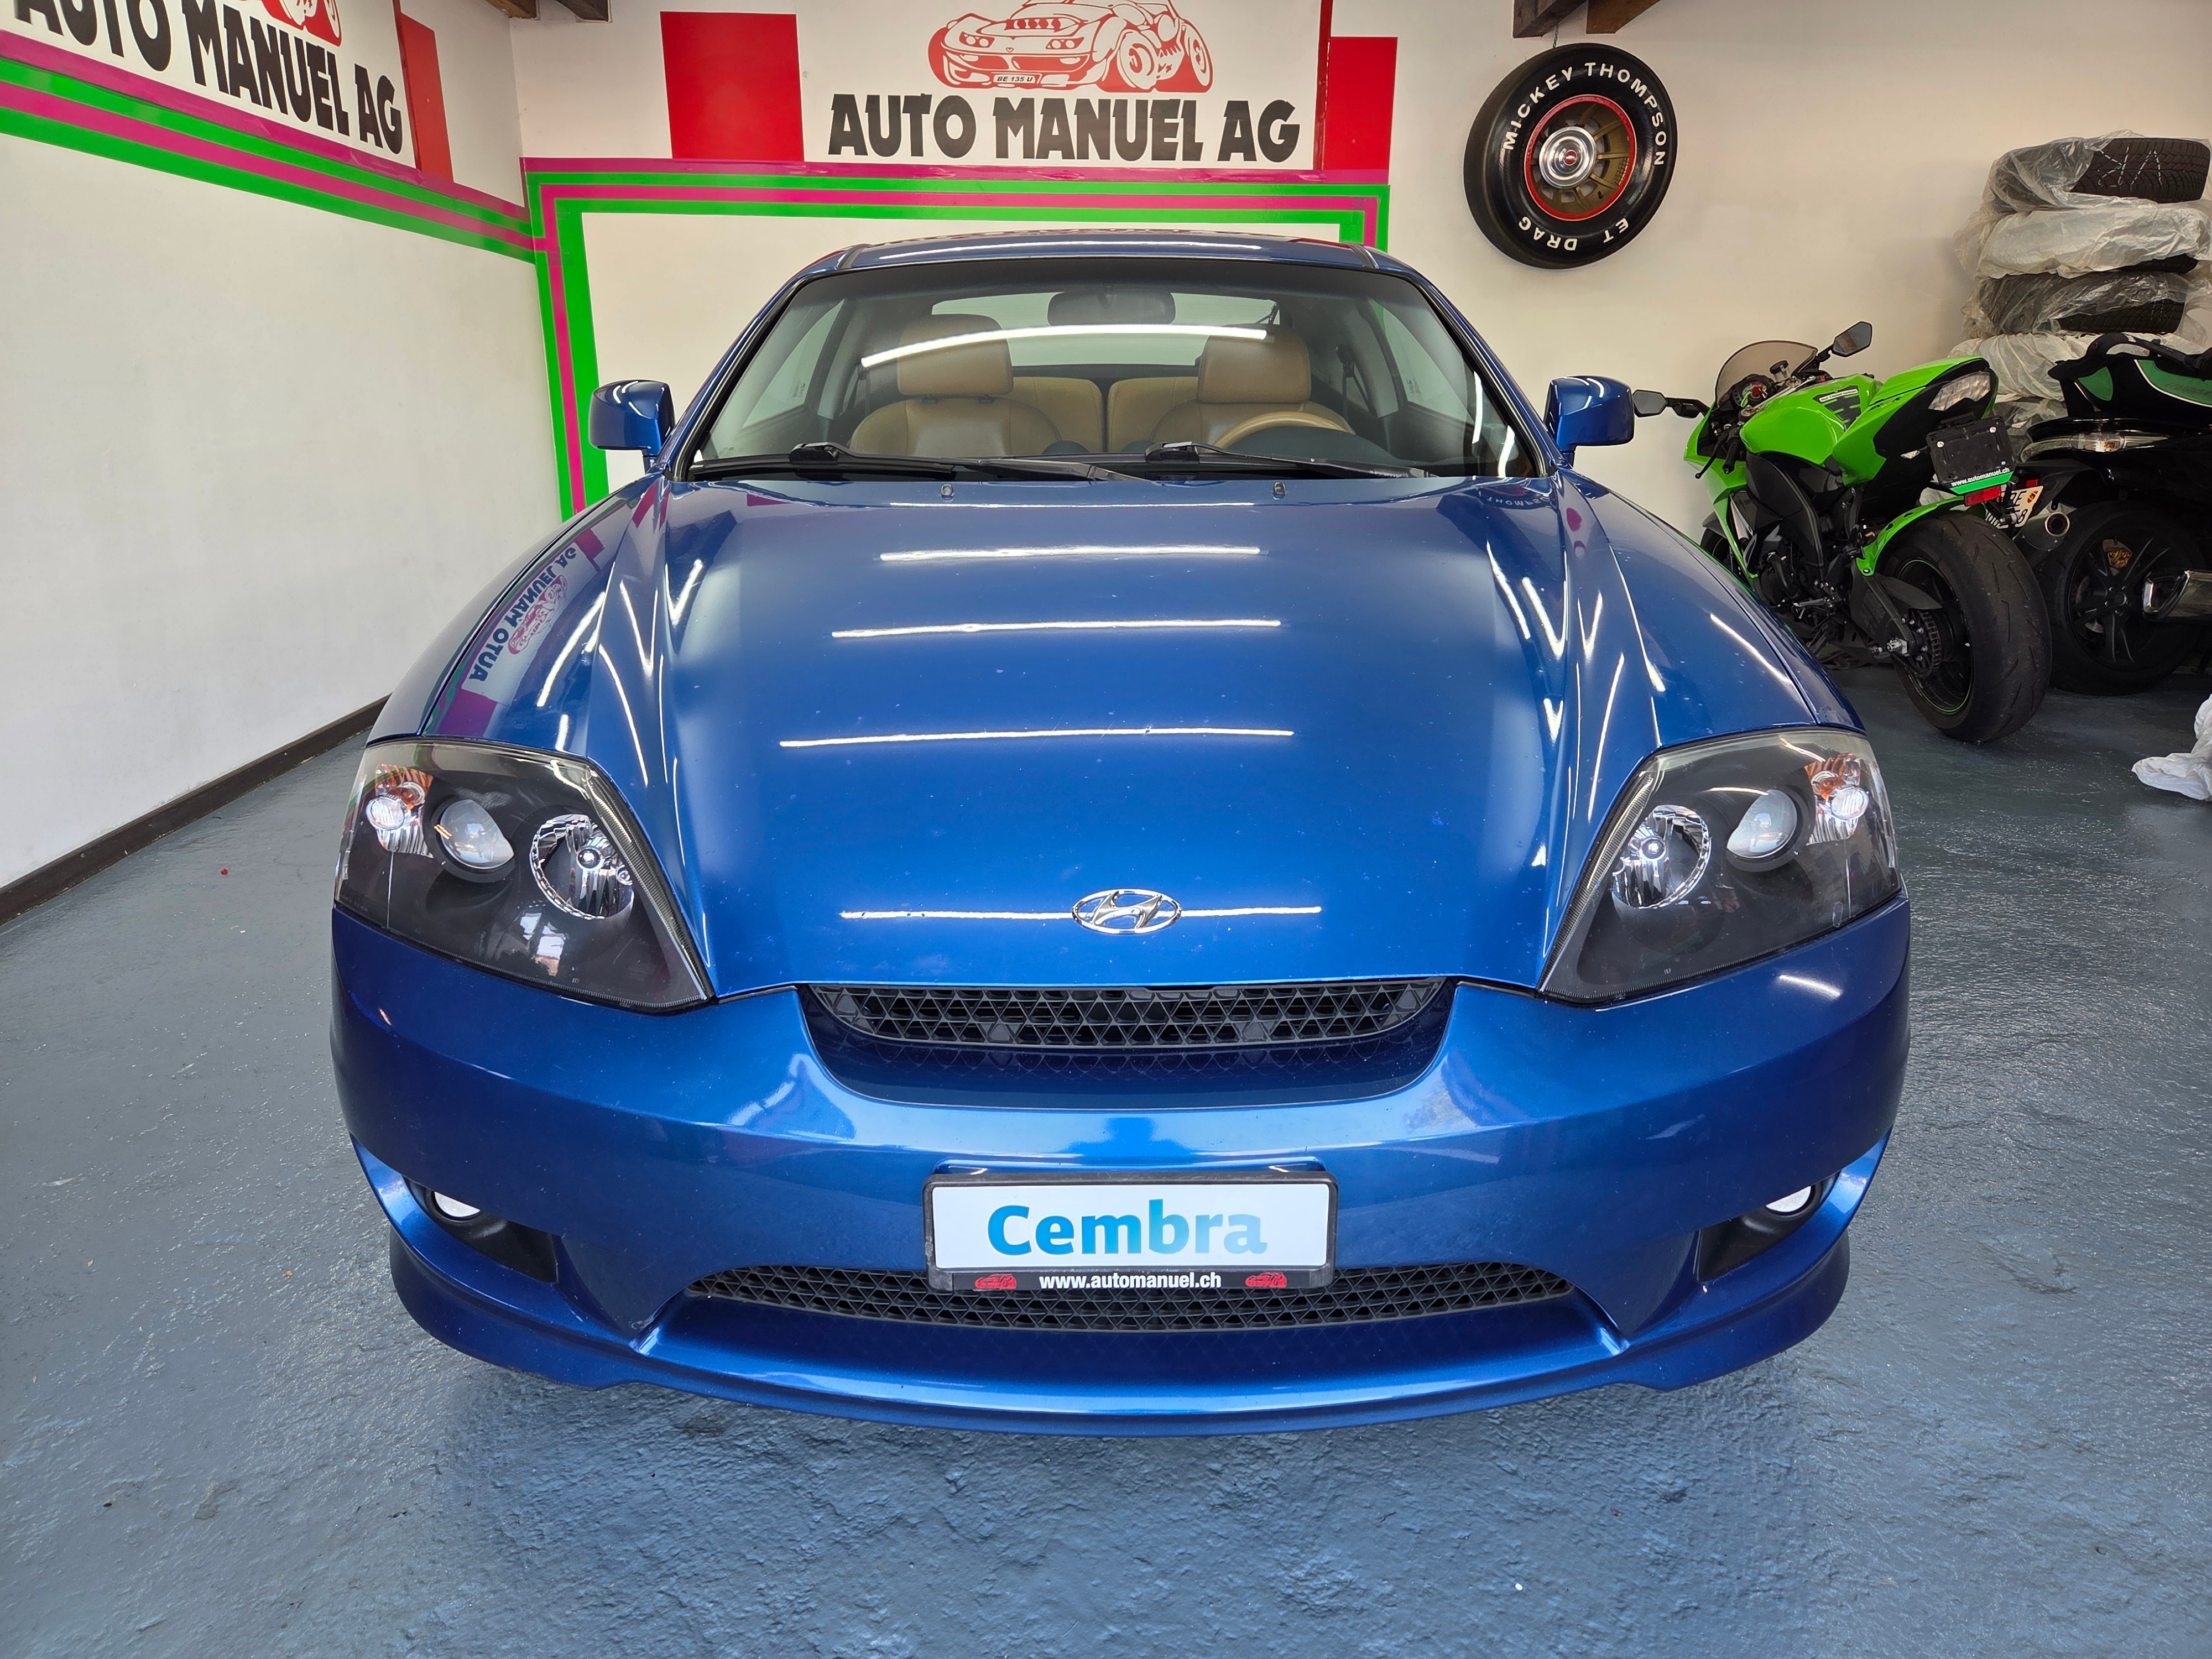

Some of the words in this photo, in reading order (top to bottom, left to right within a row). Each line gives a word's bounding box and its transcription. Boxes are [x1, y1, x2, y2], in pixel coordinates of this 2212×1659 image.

[181, 0, 349, 136] MANUEL
[354, 64, 403, 154] AG
[828, 93, 977, 159] AUTO
[993, 97, 1203, 161] MANUEL
[1217, 99, 1300, 163] AG
[1503, 66, 1572, 150] MICKEY
[1584, 62, 1666, 164] THOMPSON
[1519, 216, 1577, 251] DRAG
[1951, 467, 2010, 487] www.automanuel.ch
[988, 1198, 1267, 1256] Cembra
[1039, 1272, 1221, 1289] www.automanuel.ch
